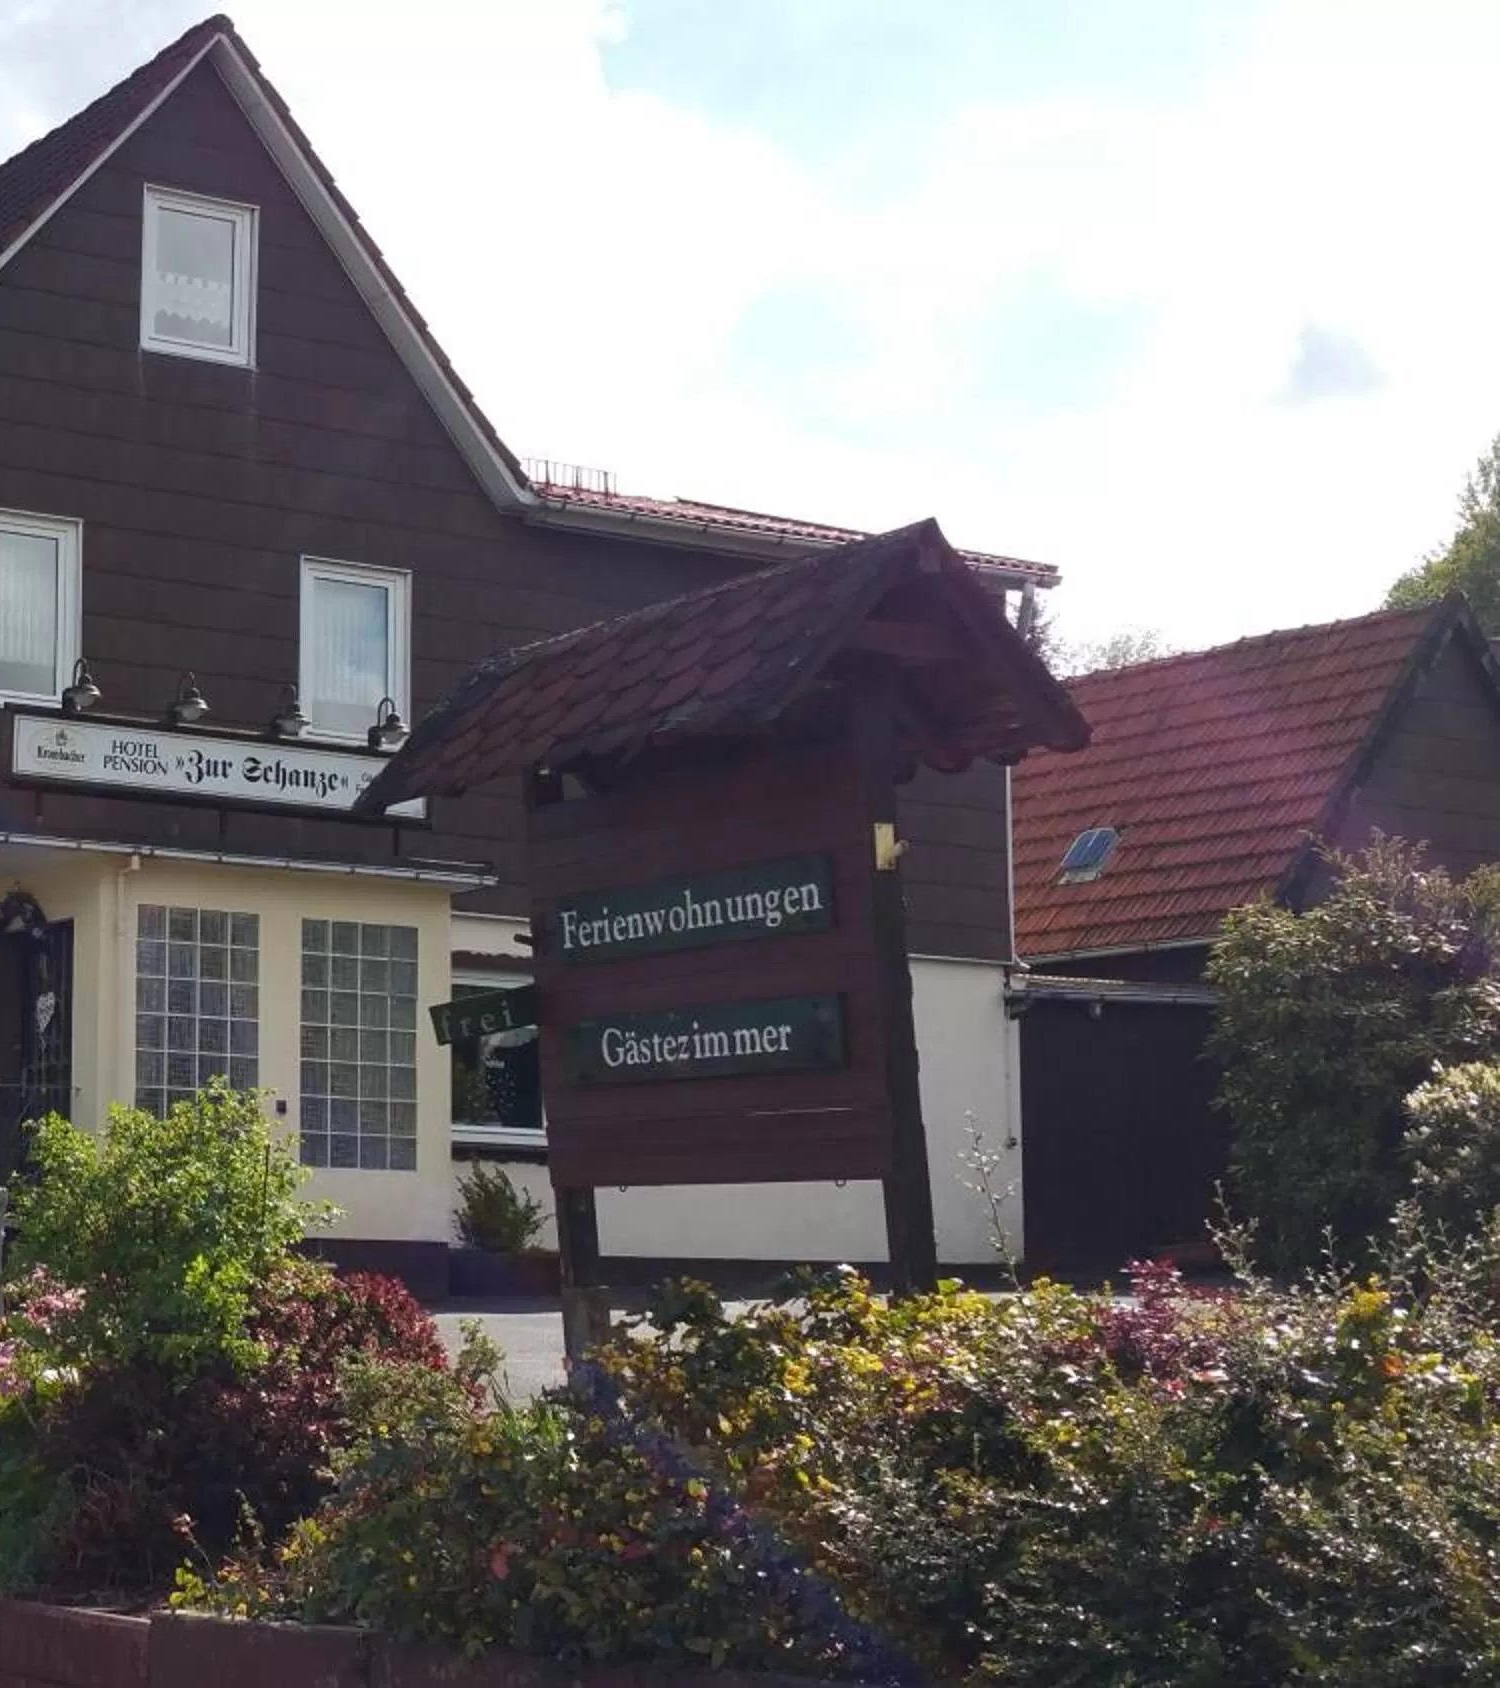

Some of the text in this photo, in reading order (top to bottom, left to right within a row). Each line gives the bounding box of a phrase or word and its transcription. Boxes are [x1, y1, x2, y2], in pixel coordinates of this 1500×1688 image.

[103, 755, 169, 775] PENSION
[111, 739, 158, 759] HOTEL
[561, 882, 824, 949] Ferienwohnungen
[601, 1019, 793, 1067] Gästezimmer
